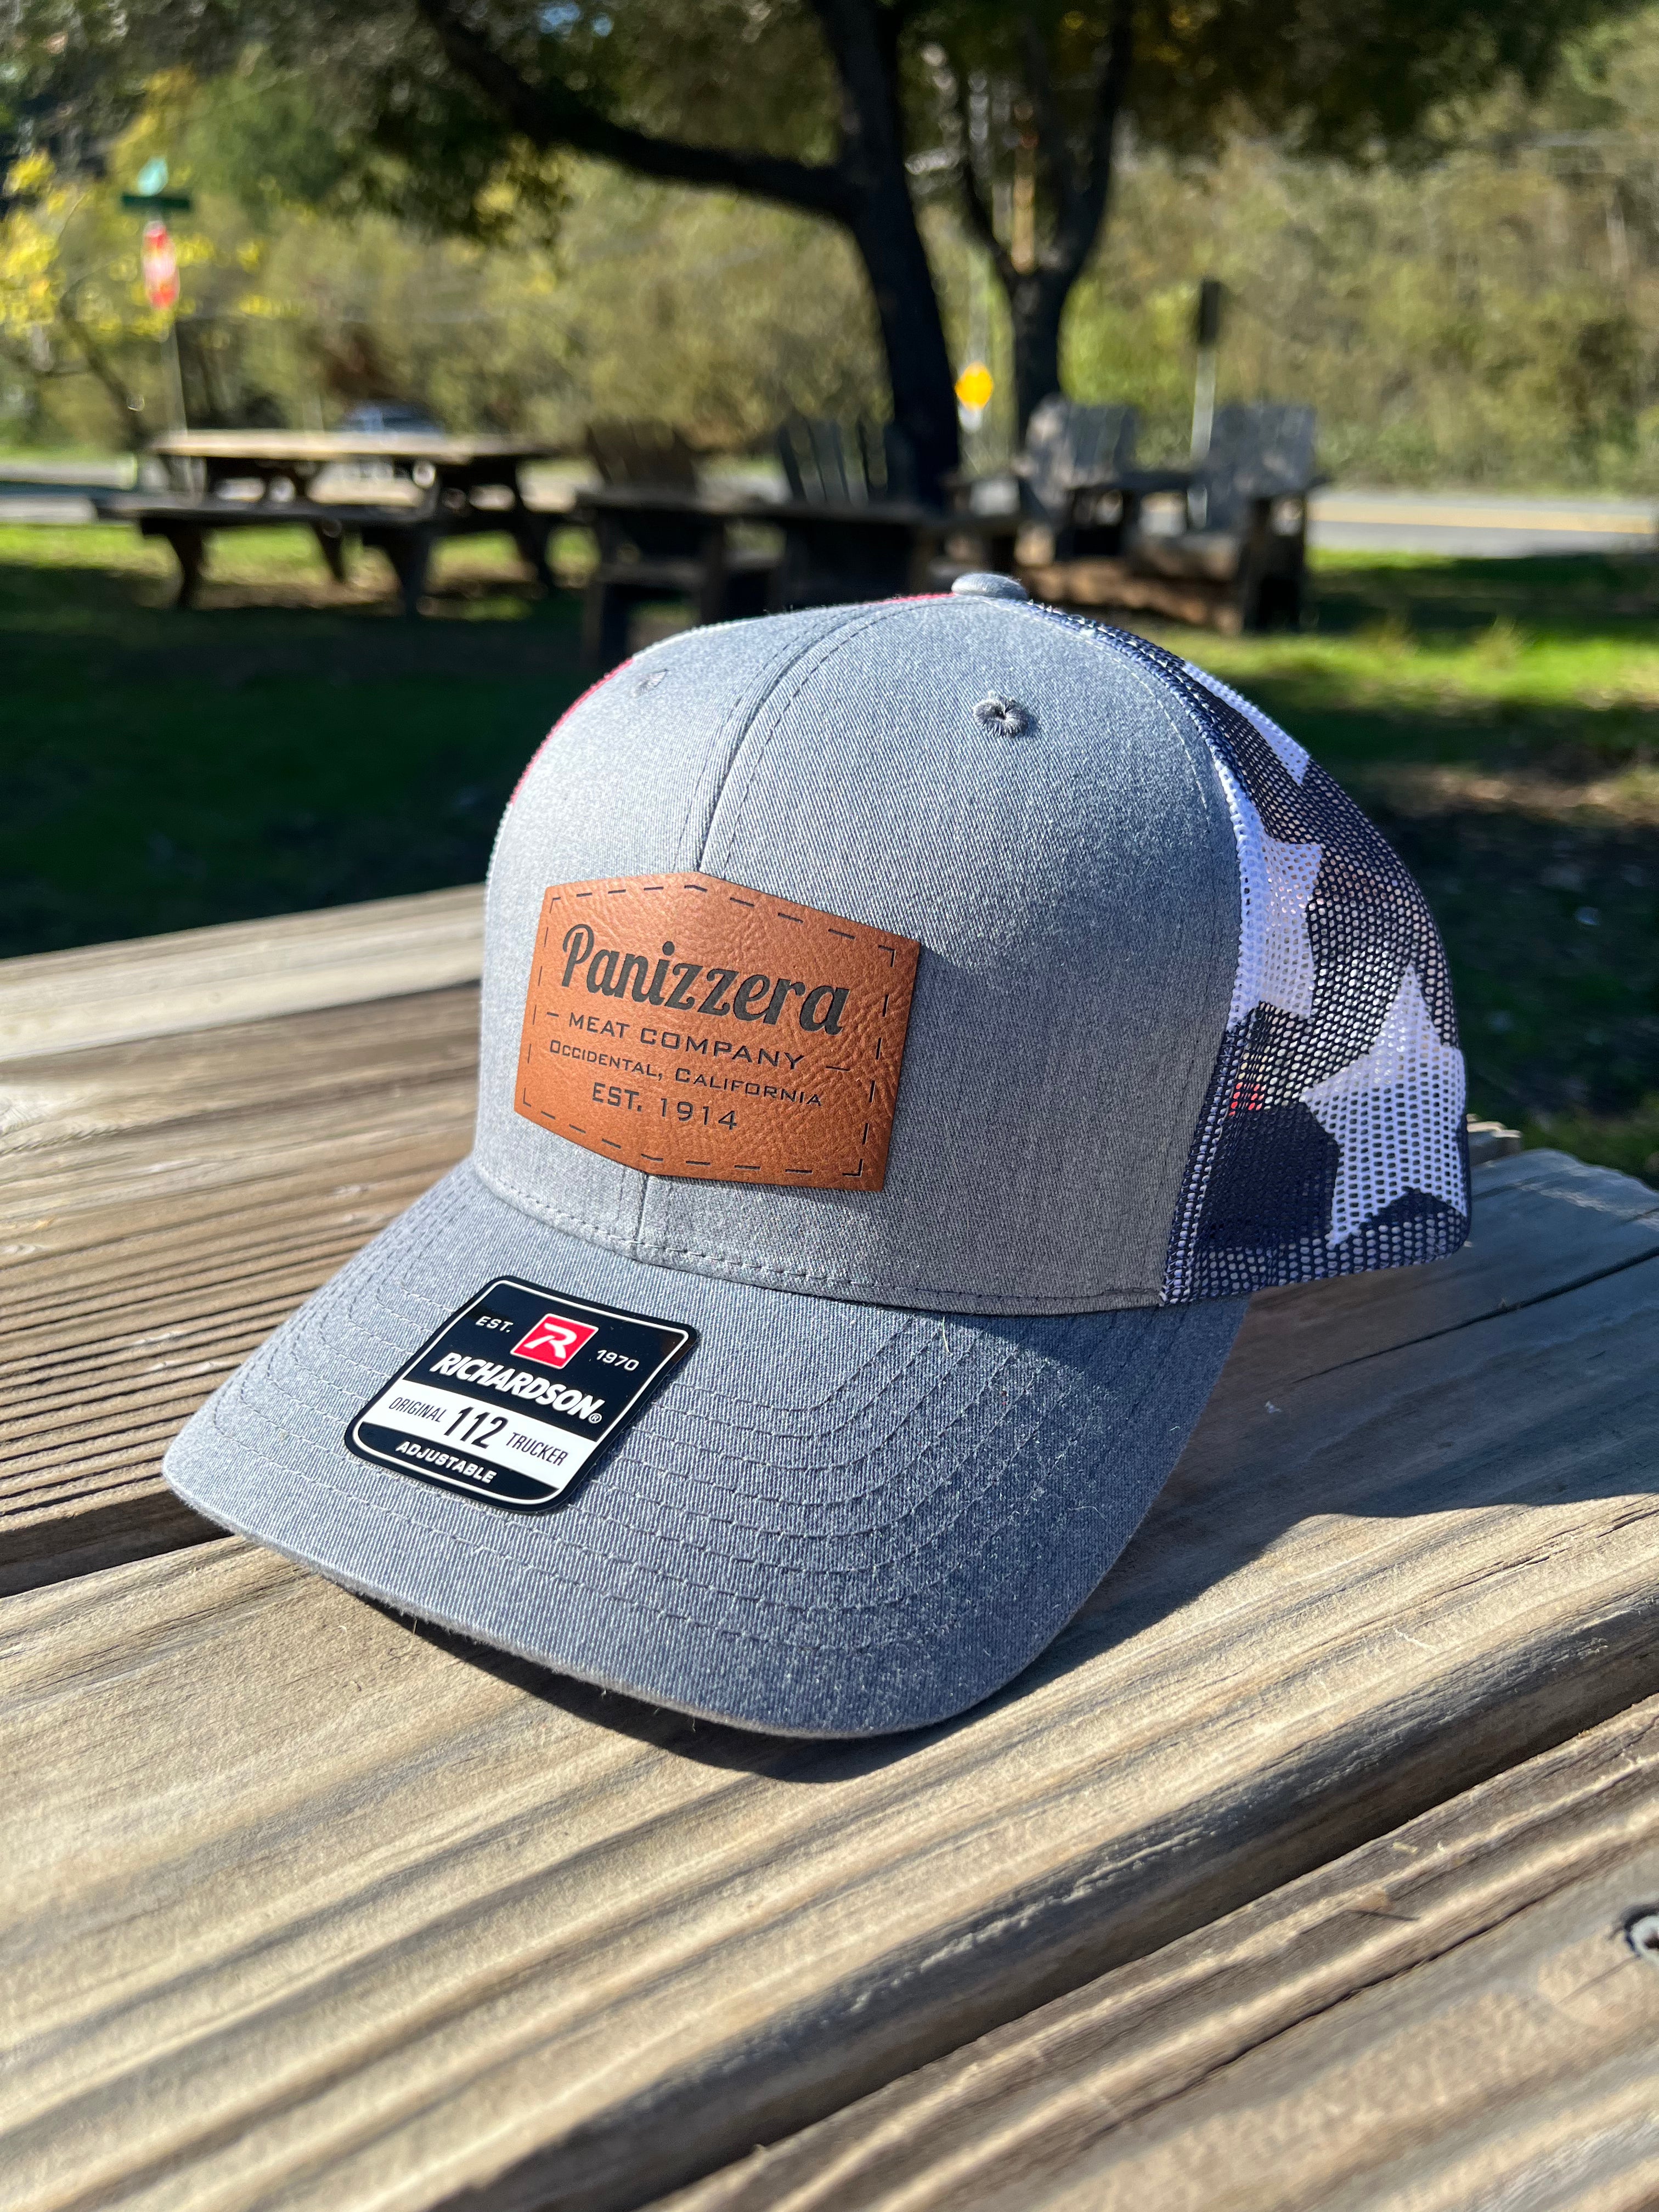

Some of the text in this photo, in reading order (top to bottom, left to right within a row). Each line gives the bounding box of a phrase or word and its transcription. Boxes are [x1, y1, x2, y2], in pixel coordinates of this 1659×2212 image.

[561, 923, 851, 1036] Panizzera
[569, 1012, 806, 1070] MEAT COMPANY
[592, 1082, 737, 1131] EST. 1914
[476, 1316, 640, 1372] EST. 1970
[524, 1323, 578, 1359] R
[388, 1397, 569, 1467] ORIGINAL 112 TRUCKER
[395, 1441, 496, 1485] ADJUSTABLE
